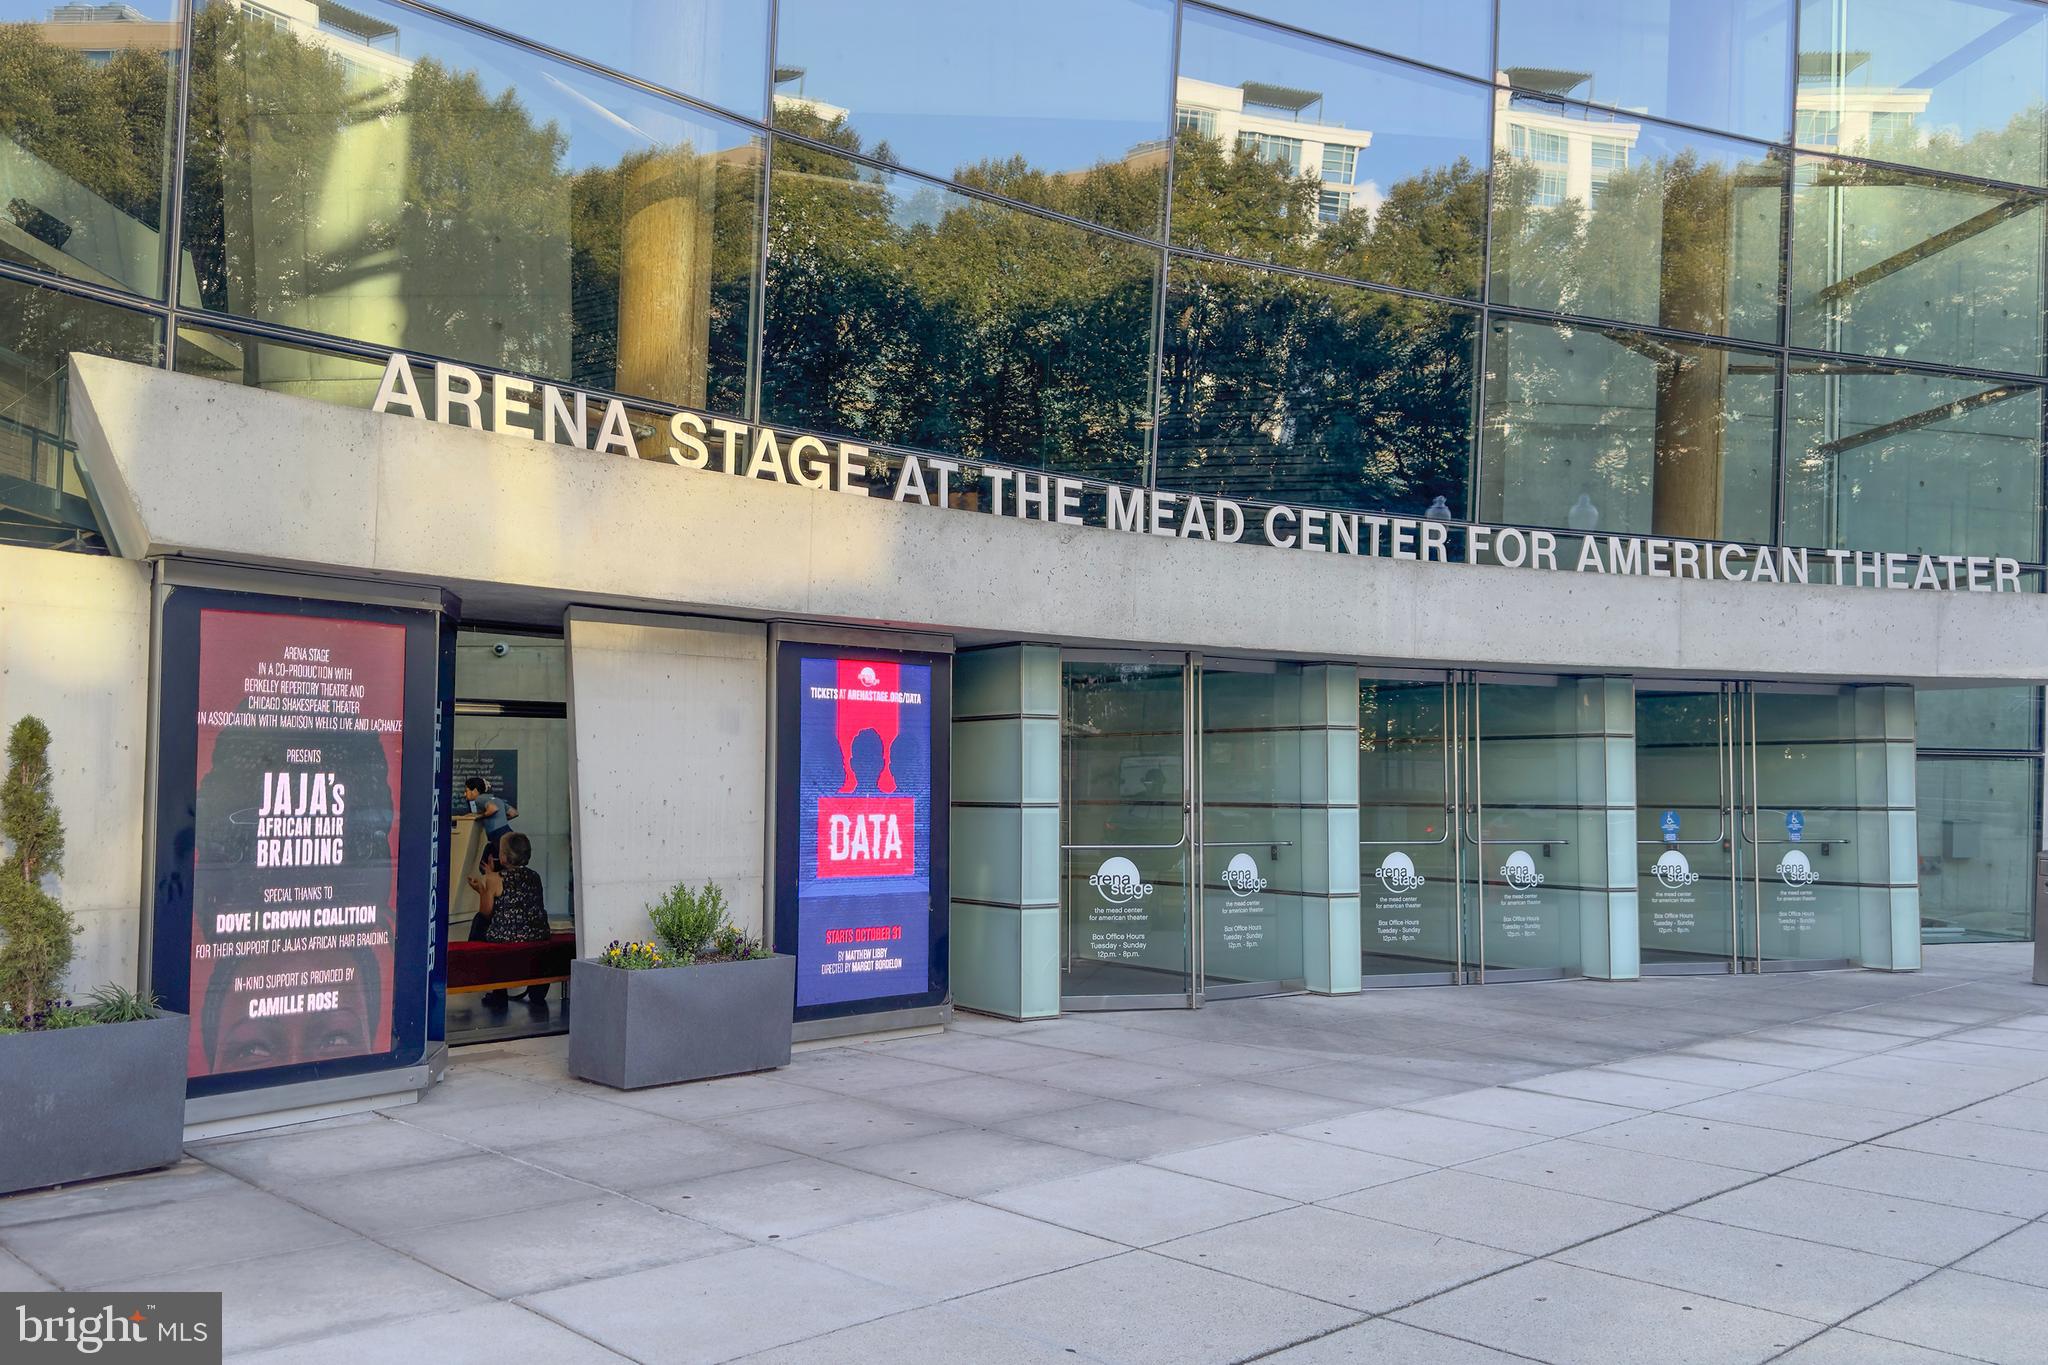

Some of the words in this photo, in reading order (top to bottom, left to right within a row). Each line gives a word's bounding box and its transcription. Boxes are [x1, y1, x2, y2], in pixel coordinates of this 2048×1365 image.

[372, 353, 640, 458] ARENA
[668, 413, 870, 497] STAGE
[893, 455, 958, 509] AT
[982, 467, 1083, 526] THE
[1107, 486, 1245, 543] MEAD
[1264, 505, 1448, 562] CENTER
[1467, 525, 1557, 570] FOR
[1577, 534, 1809, 584] AMERICAN
[1826, 549, 2022, 593] THEATER
[284, 646, 307, 660] ARENA
[309, 648, 330, 662] STAGE
[258, 662, 266, 675] IN
[268, 663, 273, 675] A
[276, 663, 333, 679] CO-PRODUCTION
[335, 667, 352, 680] WITH
[244, 678, 279, 693] BERKELEY
[281, 680, 319, 695] REPERTORY
[320, 683, 348, 697] THEATRE
[349, 685, 364, 698] AND
[811, 687, 838, 699] TICKETS
[839, 689, 847, 699] AT
[248, 696, 280, 710] CHICAGO
[282, 697, 330, 713] SHAKESPEARE
[332, 700, 360, 714] THEATER
[198, 712, 206, 725] IN
[208, 712, 256, 726] ASSOCIATION
[259, 714, 277, 727] WITH
[280, 715, 313, 728] MADISON
[315, 717, 337, 730] WELLS
[340, 718, 353, 730] LIVE
[354, 719, 368, 731] AND
[433, 701, 443, 773] THE
[286, 749, 321, 762] PRESENTS
[259, 772, 345, 816] JAJA's
[257, 818, 311, 837] AFRICAN
[315, 817, 344, 836] HAIR
[828, 814, 902, 861] DATA
[257, 838, 343, 867] BRAIDING
[1222, 870, 1251, 880] arena
[1375, 867, 1407, 877] arena
[1500, 865, 1528, 875] arena
[1651, 864, 1681, 874] arena
[1776, 864, 1803, 874] arena
[428, 789, 440, 972] KREEGER
[1089, 874, 1130, 885] arena
[1238, 878, 1267, 892] stage
[1392, 875, 1425, 889] stage
[1515, 873, 1544, 887] stage
[1668, 872, 1699, 885] stage
[1791, 871, 1819, 884] stage
[264, 888, 293, 902] SPECIAL
[294, 887, 322, 900] THANKS
[324, 886, 332, 899] TO
[1111, 883, 1153, 899] stage
[216, 913, 251, 933] DOVE
[263, 909, 310, 930] CROWN
[314, 906, 376, 927] COALITION
[826, 928, 853, 944] STARTS
[856, 927, 890, 942] OCTOBER
[892, 926, 902, 940] 31
[196, 944, 211, 958] FOR
[213, 943, 234, 957] THEIR
[236, 940, 269, 955] SUPPORT
[272, 939, 281, 953] OF
[308, 936, 337, 950] AFRICAN
[339, 934, 355, 948] HAIR
[1091, 942, 1117, 950] Tuesday
[838, 951, 845, 961] BY
[845, 949, 872, 961] MATTHEW
[872, 948, 888, 958] LIBBY
[822, 962, 843, 974] DIRECTED
[845, 962, 851, 972] BY
[852, 961, 874, 972] MARGOT
[235, 976, 263, 992] IN-KIND
[266, 972, 299, 988] SUPPORT
[301, 972, 308, 985] IS
[310, 969, 343, 984] PROVIDED
[346, 968, 355, 980] BY
[249, 994, 304, 1018] CAMILLE
[307, 991, 339, 1011] ROSE
